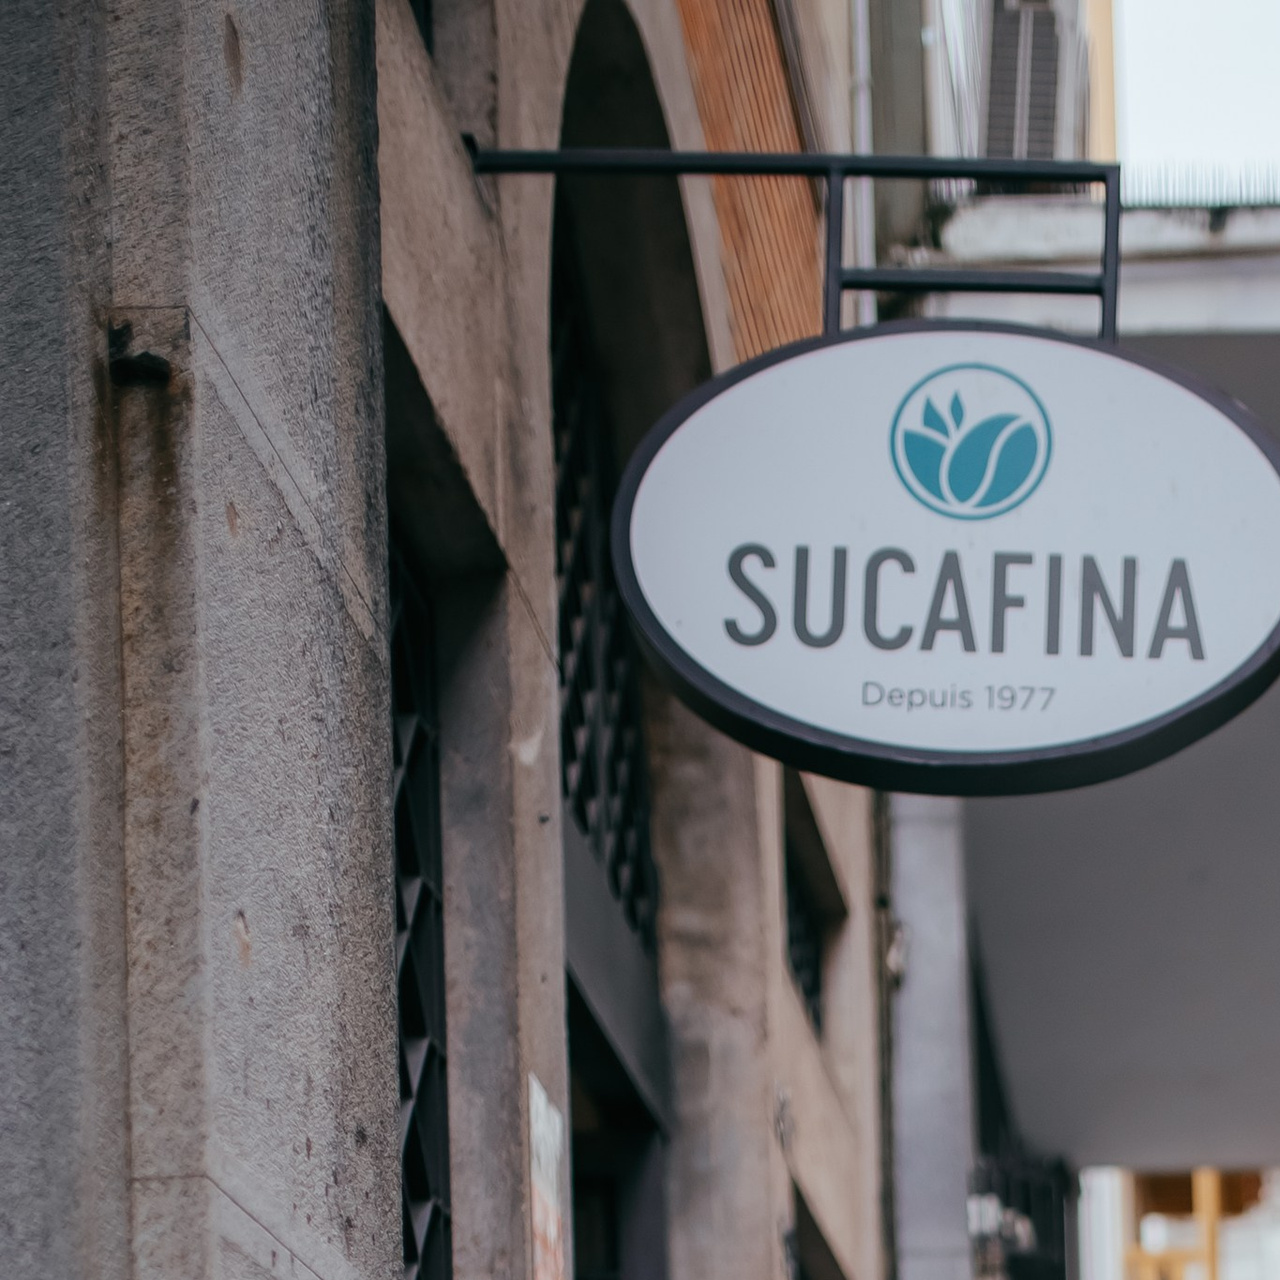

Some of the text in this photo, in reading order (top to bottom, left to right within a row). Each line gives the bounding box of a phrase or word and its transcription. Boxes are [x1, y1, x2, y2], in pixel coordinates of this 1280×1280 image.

[724, 542, 1206, 661] SUCAFINA
[861, 681, 1057, 713] Depuis 1977
